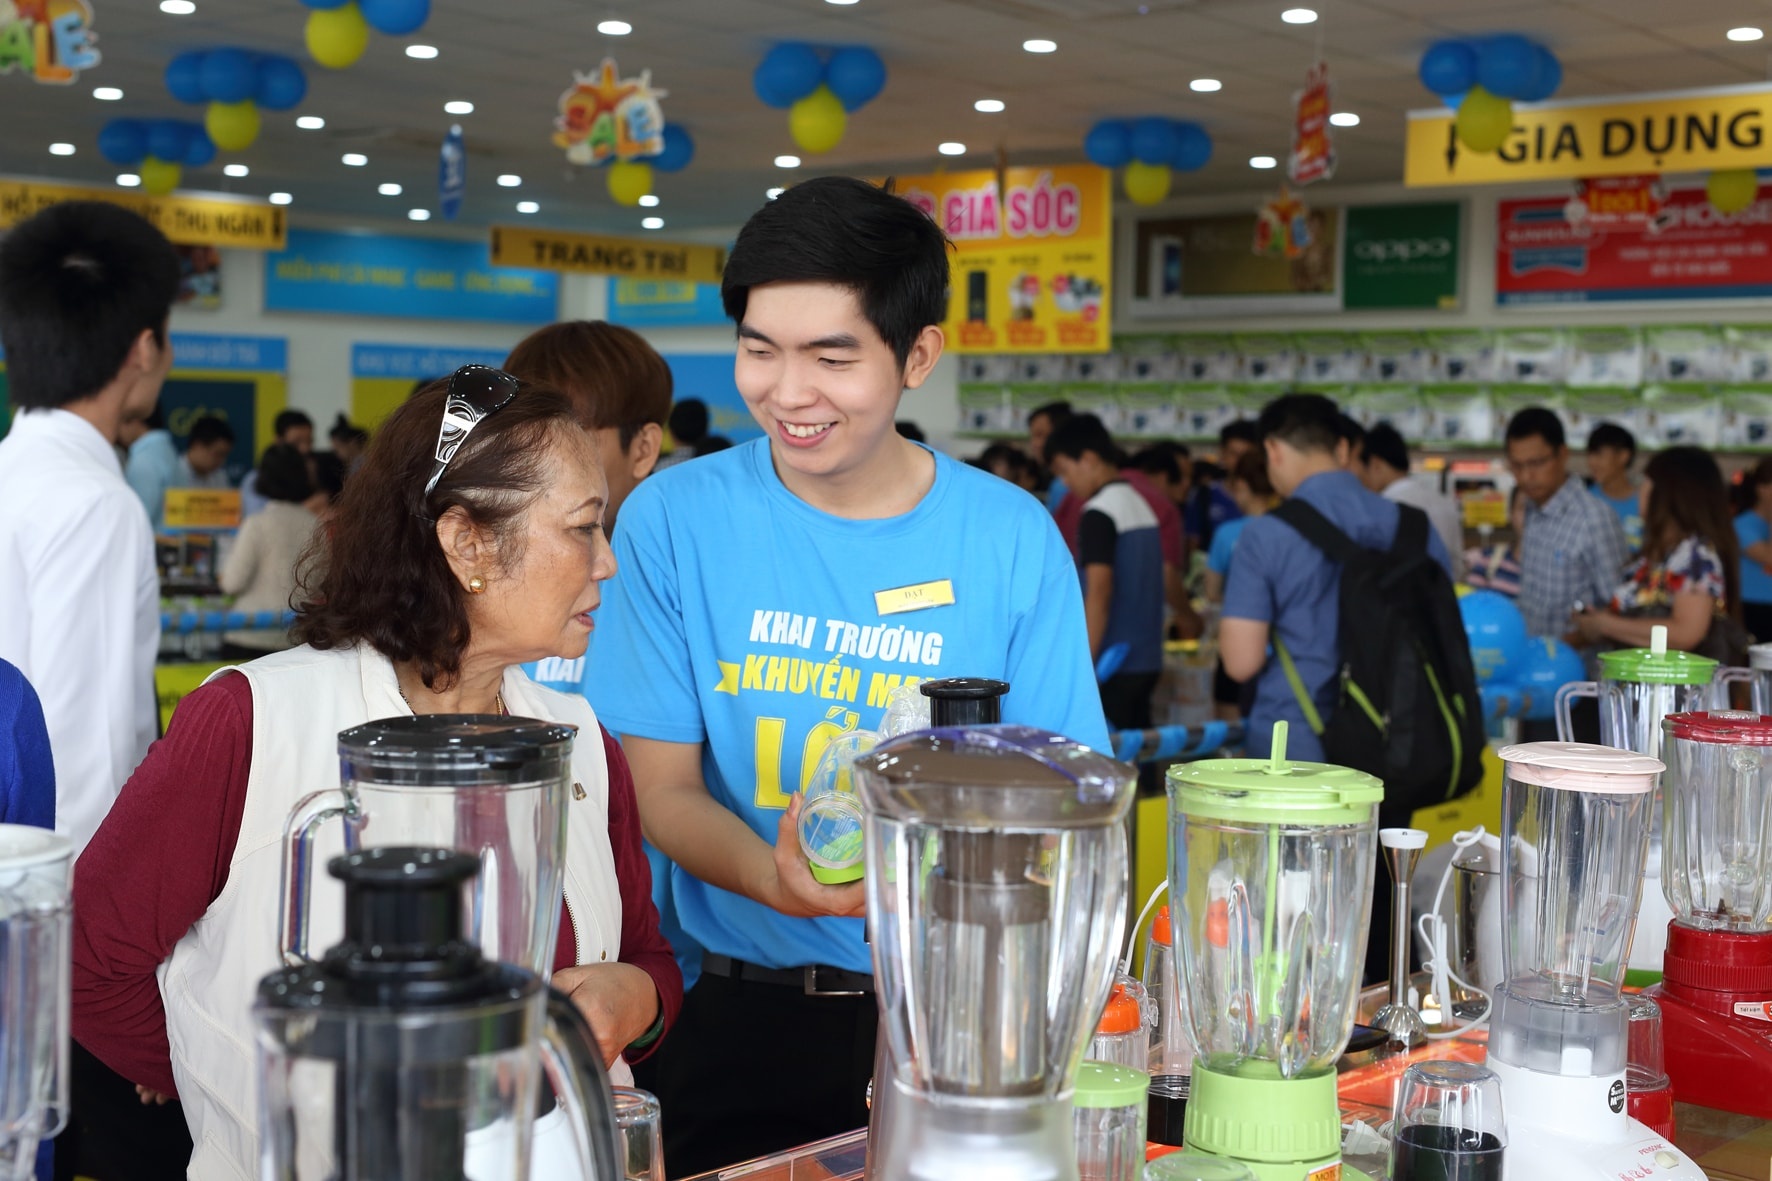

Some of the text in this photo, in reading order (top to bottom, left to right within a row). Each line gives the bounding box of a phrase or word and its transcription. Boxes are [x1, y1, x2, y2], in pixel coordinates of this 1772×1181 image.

[1498, 109, 1763, 166] GIA DỤNG
[944, 181, 998, 236] GIÁ
[1008, 173, 1077, 233] SỐC
[532, 239, 636, 272] TRANG
[749, 609, 944, 666] KHAI TRƯƠNG
[742, 653, 861, 703] KHUYẾN
